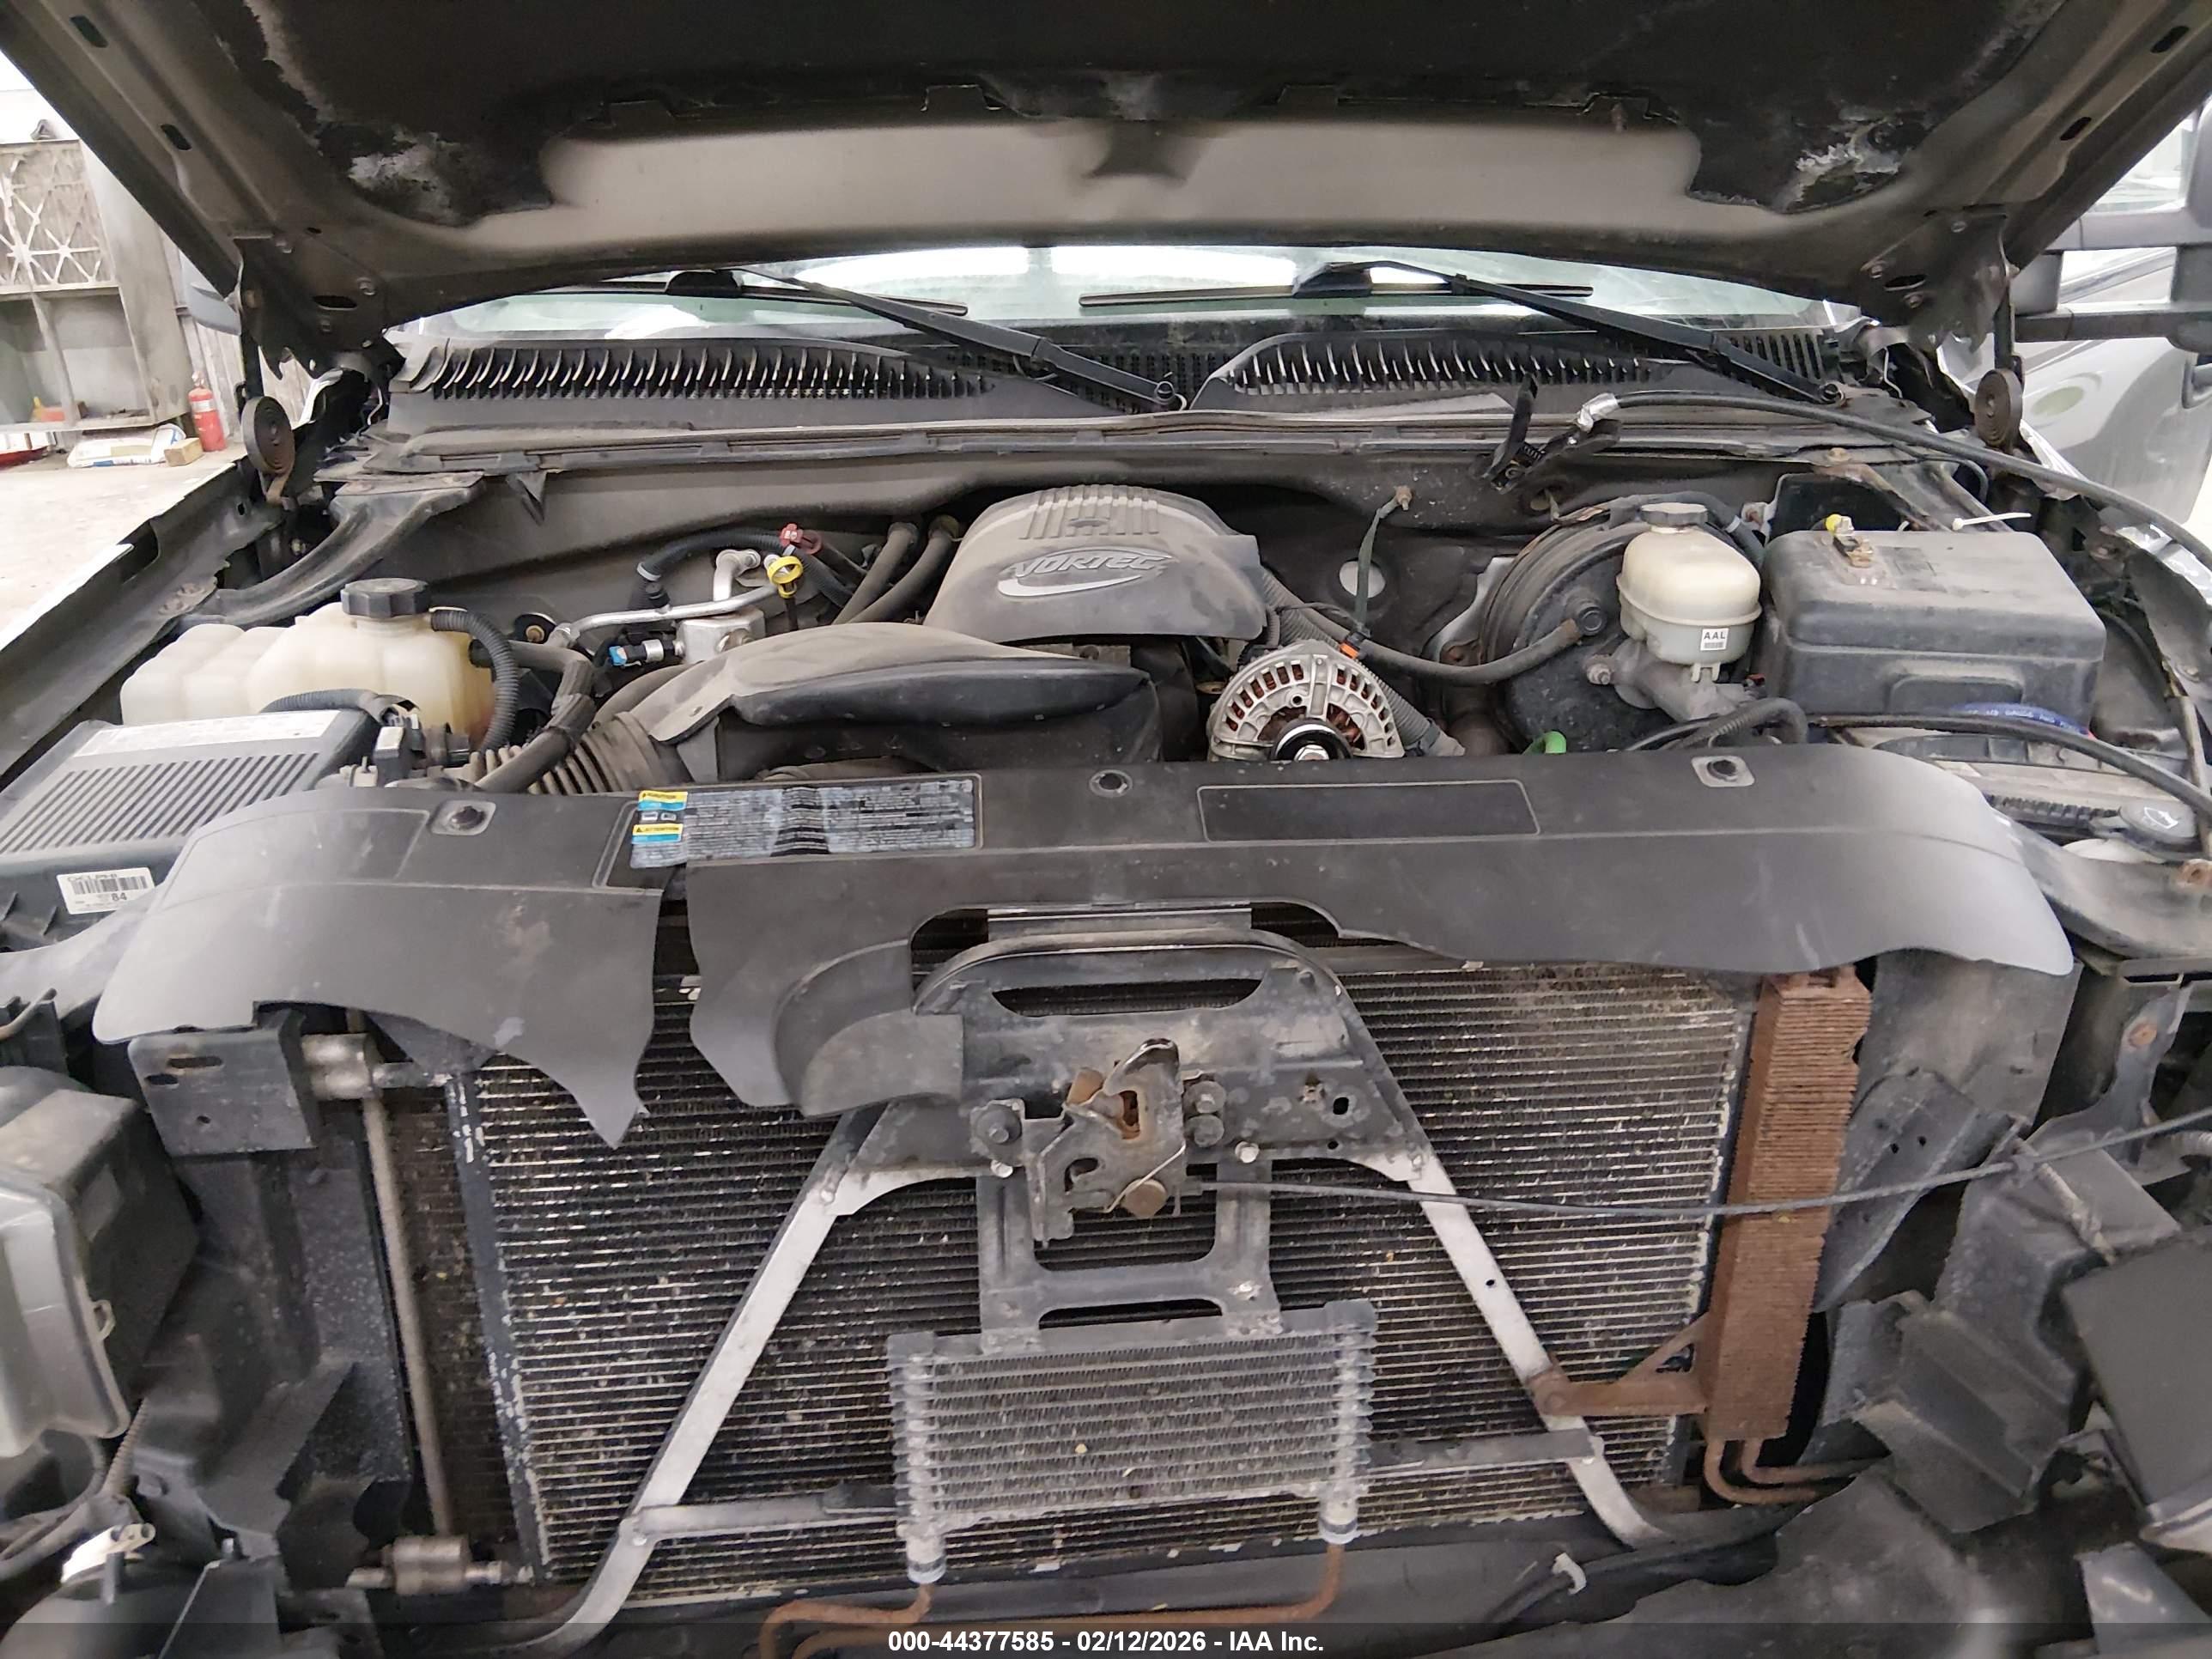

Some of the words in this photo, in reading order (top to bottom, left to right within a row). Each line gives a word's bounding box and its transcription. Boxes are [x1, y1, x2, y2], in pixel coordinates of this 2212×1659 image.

[1014, 555, 1164, 578] VORTEC
[1703, 631, 1726, 640] AAL
[111, 891, 127, 902] 84
